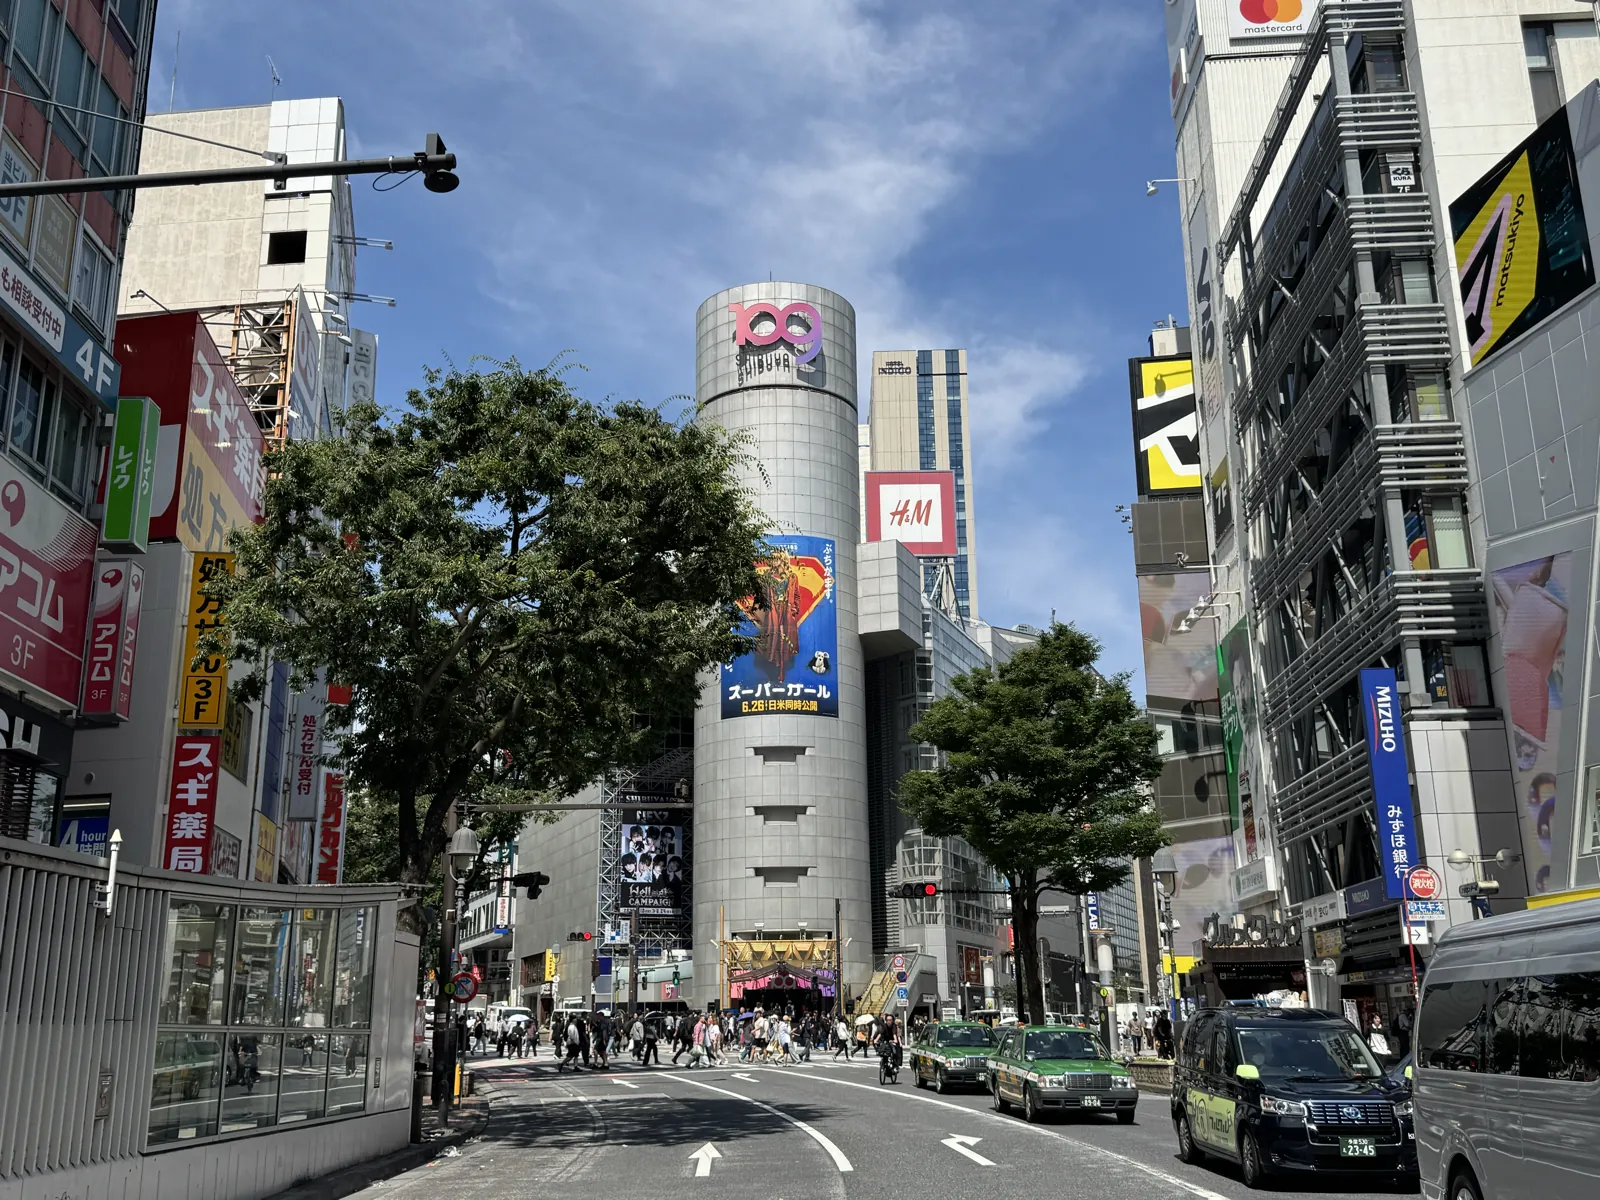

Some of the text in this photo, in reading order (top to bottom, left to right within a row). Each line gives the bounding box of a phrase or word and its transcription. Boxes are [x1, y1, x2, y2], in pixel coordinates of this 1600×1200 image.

[1244, 24, 1303, 34] mastercard
[1495, 193, 1525, 307] matsukiyo
[728, 302, 823, 365] 109
[75, 338, 115, 394] 4F
[734, 352, 790, 367] SHIBUYA
[878, 367, 912, 375] INDIGO
[113, 445, 133, 490] レイク
[141, 448, 152, 496] レイク
[180, 451, 236, 553] 処方
[889, 498, 933, 527] H&M
[822, 543, 835, 604] ぶちかます。
[10, 634, 36, 670] 3F
[90, 623, 117, 682] アコム
[120, 626, 136, 686] アコム
[91, 689, 108, 700] 3F
[119, 692, 128, 703] 3F
[193, 678, 213, 721] 3F
[728, 682, 831, 700] スーパーガール
[741, 700, 765, 713] 6.26
[768, 699, 818, 712] 日米同時公開
[1375, 685, 1397, 753] MIZUHO
[296, 714, 317, 796] 処方せん受付
[168, 742, 214, 873] スギ薬局
[81, 830, 107, 842] hour
[1387, 804, 1410, 879] みずほ銀行
[628, 897, 675, 907] CAMPAIGN
[1411, 877, 1435, 889] 消火栓
[1087, 906, 1099, 930] LAB
[1347, 1145, 1375, 1156] 23-45
